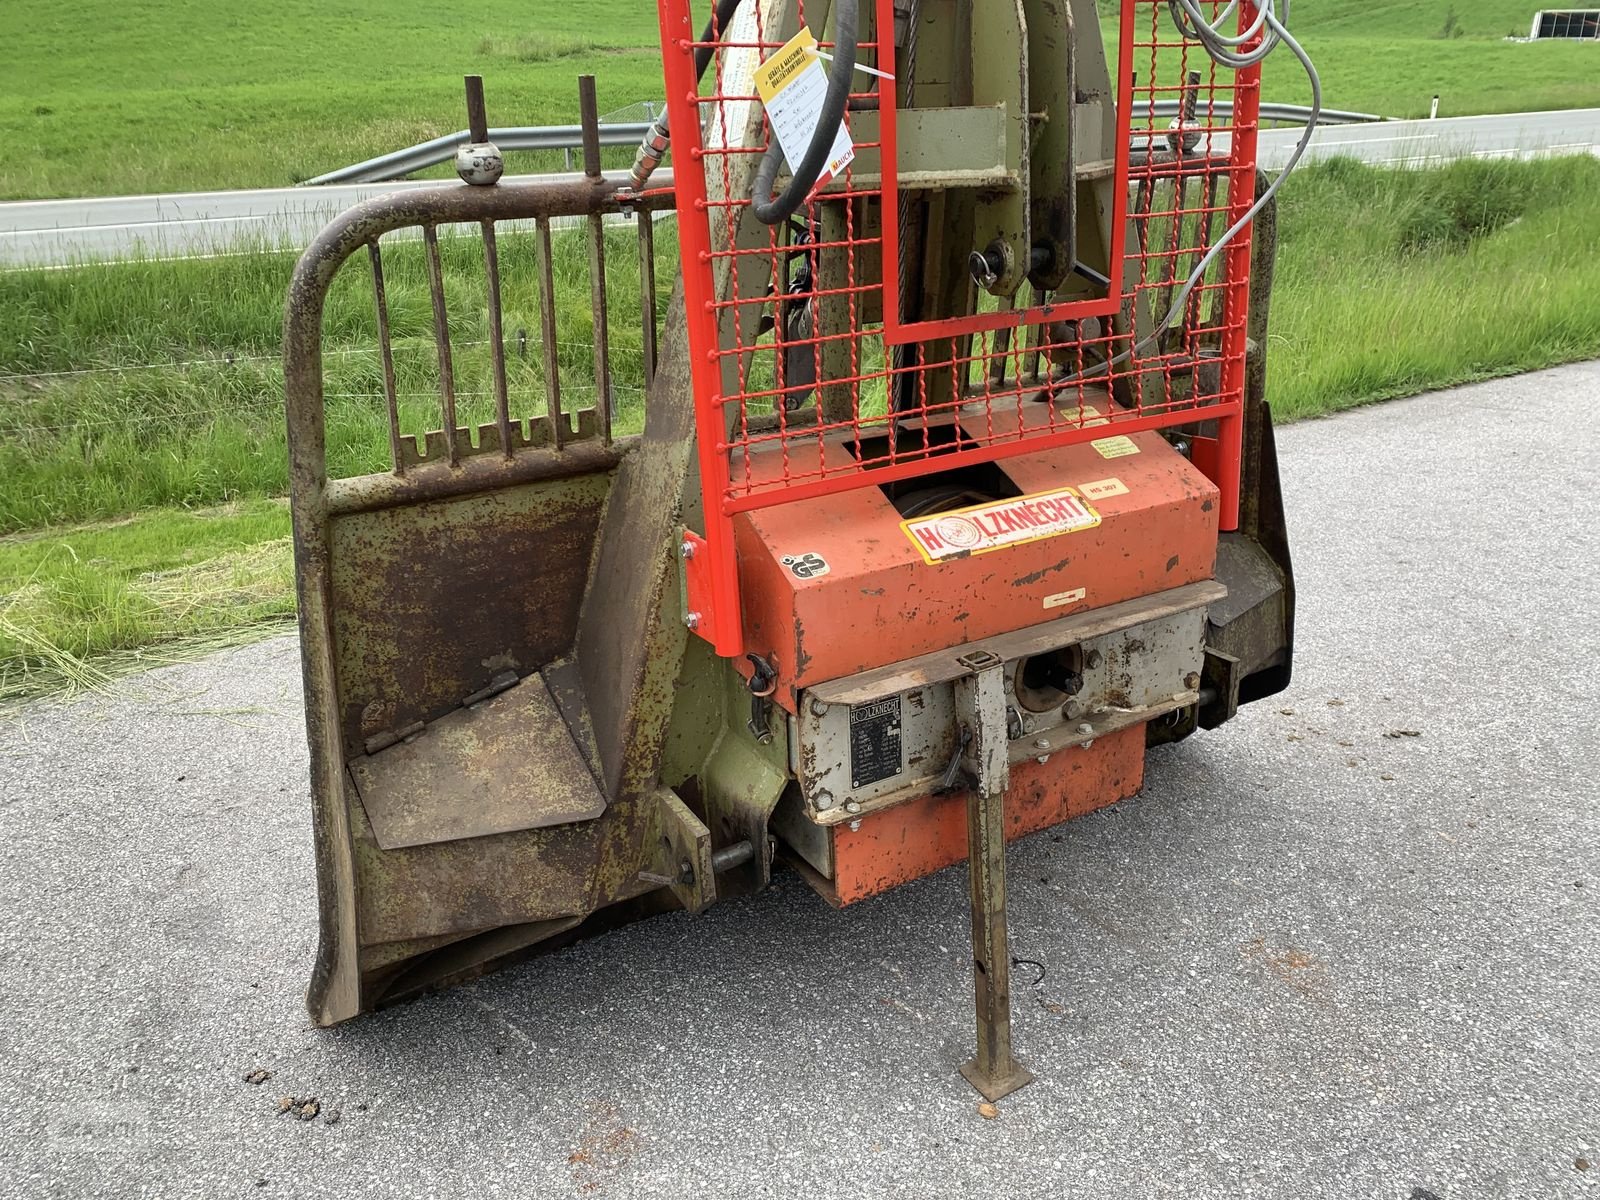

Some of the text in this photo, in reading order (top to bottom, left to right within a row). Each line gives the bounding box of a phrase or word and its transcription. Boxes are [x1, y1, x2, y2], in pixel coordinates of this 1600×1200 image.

[783, 46, 803, 69] MASCHINEN
[832, 150, 852, 172] MAUCH
[915, 495, 1085, 551] HOLZKNECHT
[791, 553, 826, 578] GS
[850, 699, 900, 722] HOLZKNECHT
